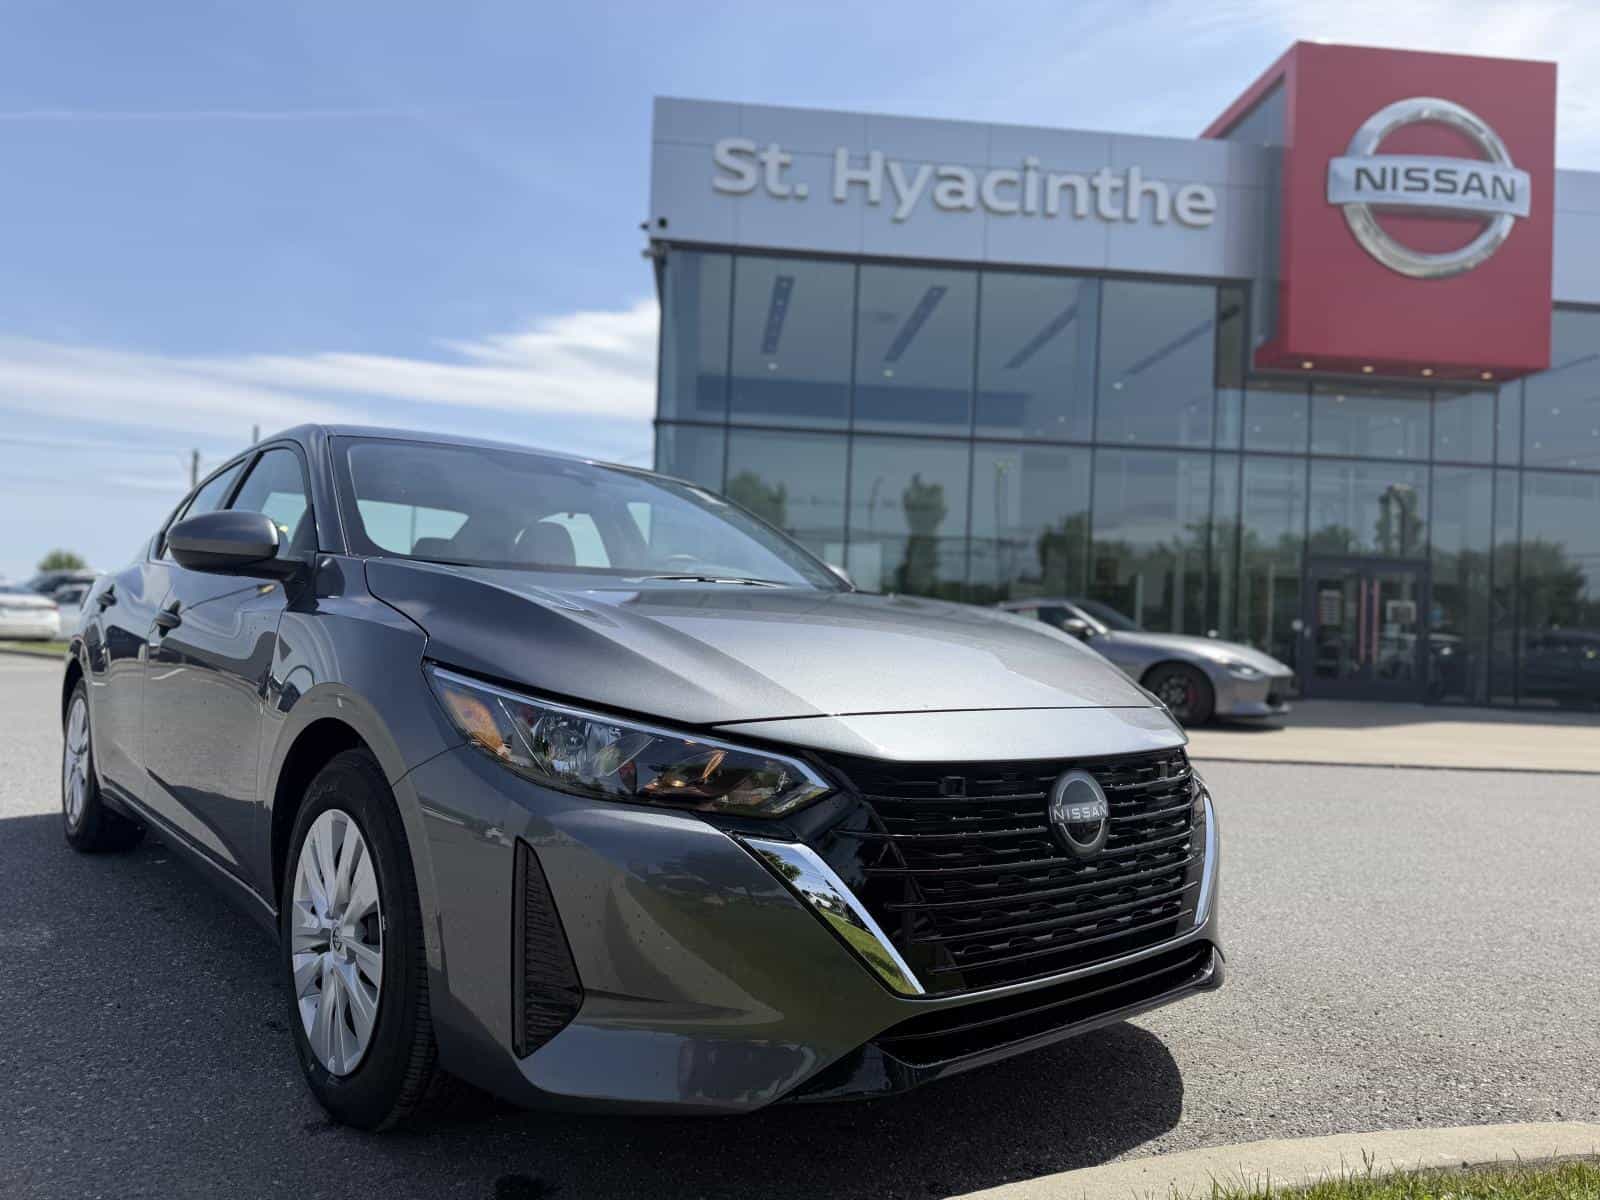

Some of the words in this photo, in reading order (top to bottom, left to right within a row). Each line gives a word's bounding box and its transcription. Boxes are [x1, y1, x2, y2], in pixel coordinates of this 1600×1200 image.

[713, 138, 808, 198] St.
[833, 147, 1218, 226] Hyacinthe
[1354, 166, 1516, 204] NISSAN
[1053, 806, 1107, 821] NISSAN
